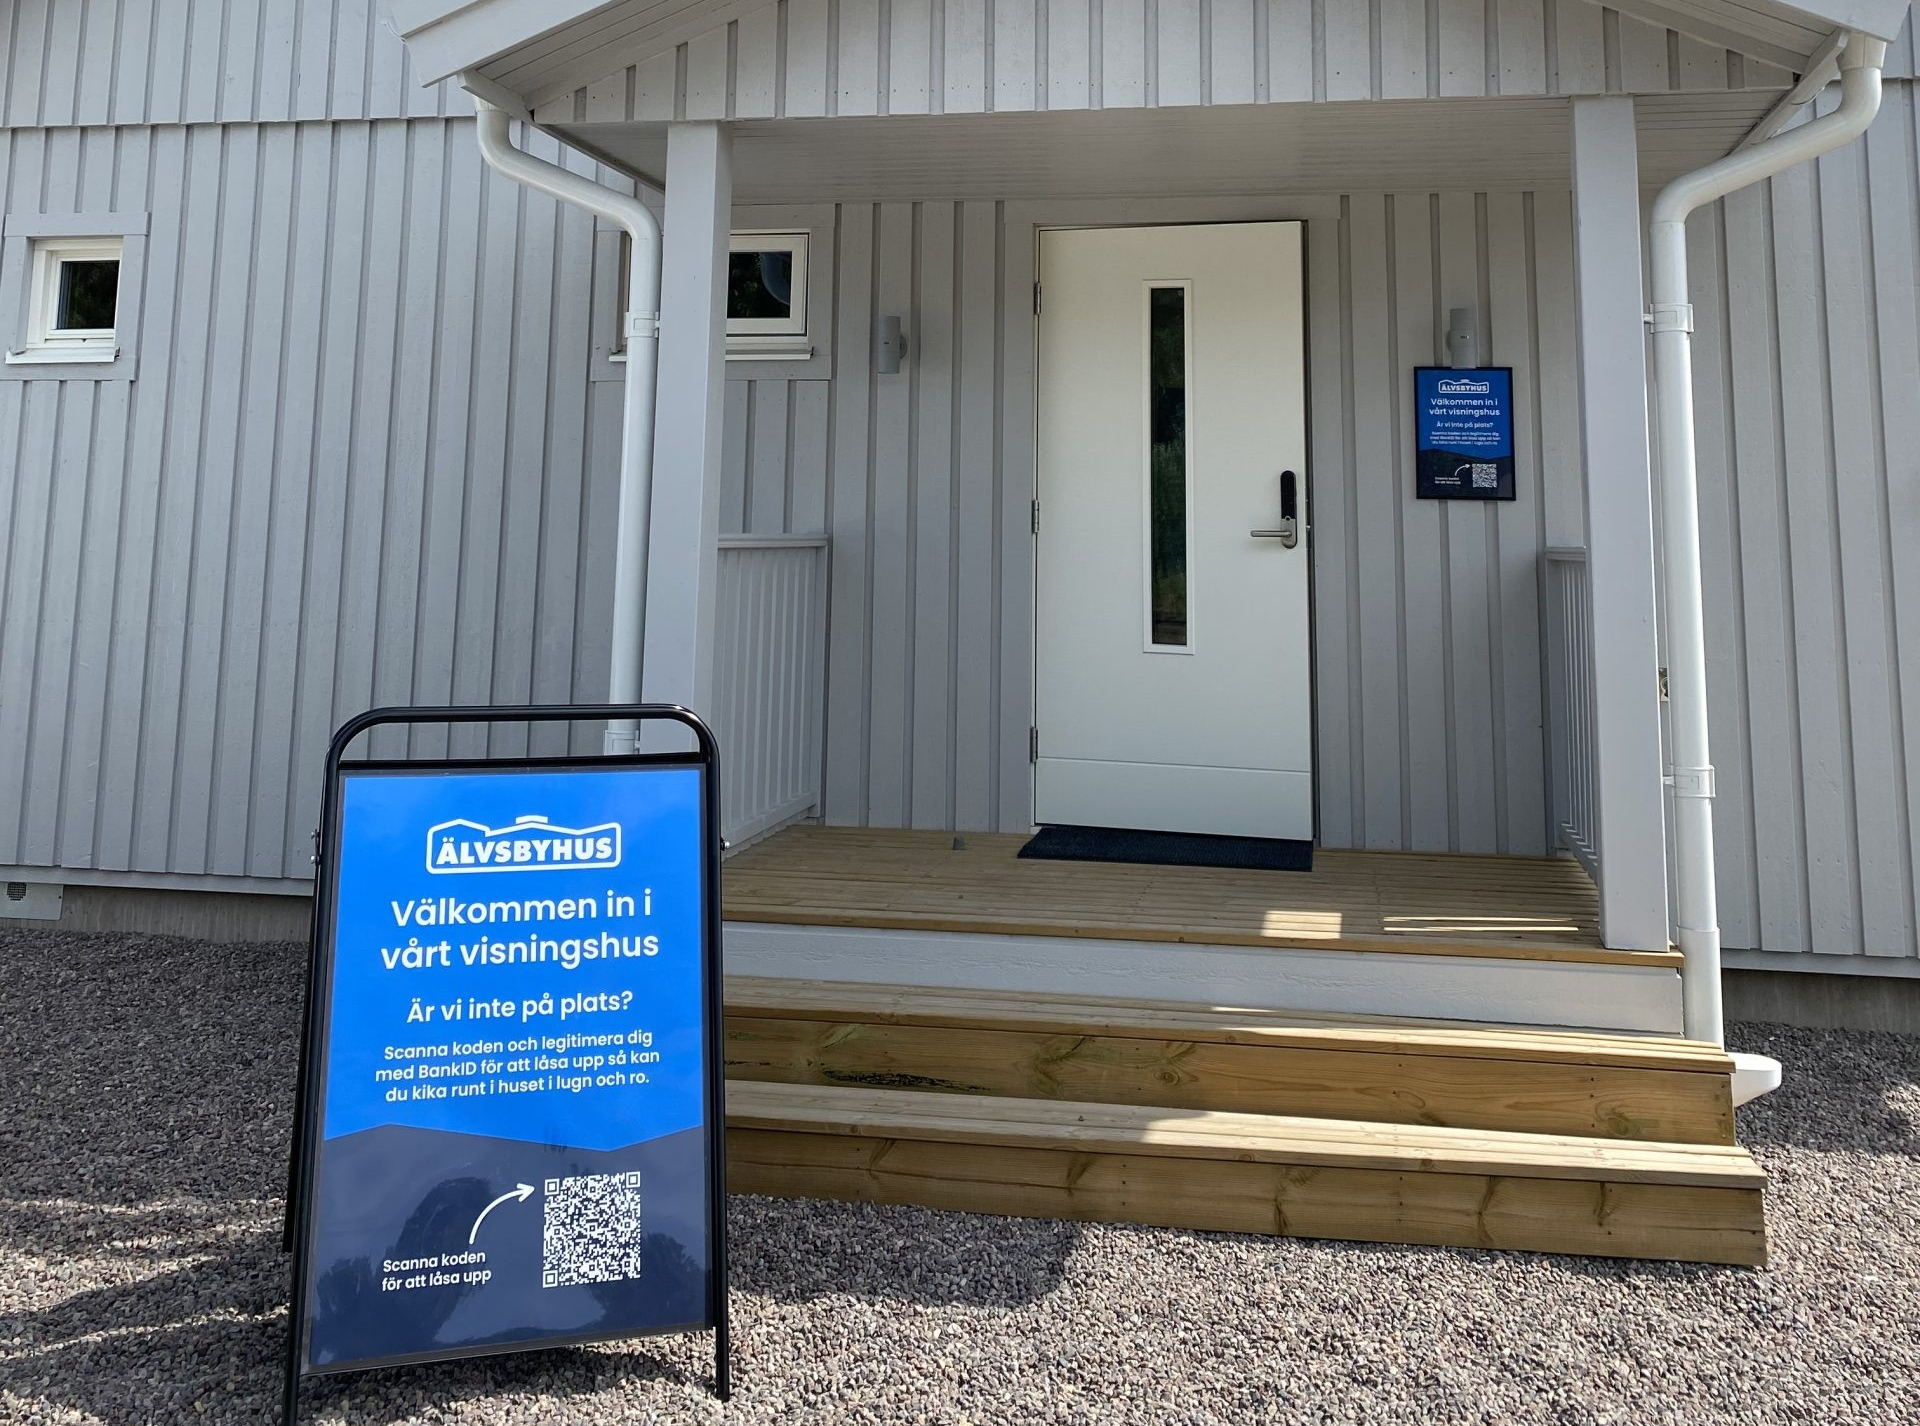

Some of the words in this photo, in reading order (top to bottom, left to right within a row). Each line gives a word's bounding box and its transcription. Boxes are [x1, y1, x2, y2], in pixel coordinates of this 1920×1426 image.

[1429, 407, 1446, 415] vårt
[1449, 408, 1500, 417] visningshus
[436, 836, 613, 865] ÄLVSBYHUS
[391, 896, 597, 927] Välkommen
[605, 889, 635, 918] in
[643, 888, 652, 916] i
[380, 937, 452, 969] vårt
[460, 932, 660, 969] visningshus
[406, 997, 436, 1023] Är
[440, 997, 463, 1021] vi
[468, 996, 516, 1019] inte
[522, 992, 555, 1022] på
[560, 990, 634, 1019] plats?
[383, 1044, 449, 1060] Scanna
[452, 1040, 504, 1057] koden
[507, 1037, 538, 1053] och
[541, 1032, 624, 1052] legitimera
[626, 1029, 653, 1048] dig
[375, 1066, 414, 1082] med
[418, 1060, 477, 1078] BankID
[480, 1059, 504, 1074] för
[506, 1058, 531, 1073] att
[534, 1054, 569, 1071] låsa
[572, 1055, 604, 1074] upp
[607, 1050, 627, 1067] så
[630, 1048, 660, 1064] kan
[385, 1085, 408, 1103] du
[411, 1081, 448, 1100] kika
[450, 1079, 487, 1097] runt
[489, 1078, 495, 1094] i
[498, 1076, 545, 1094] huset
[548, 1075, 553, 1091] i
[556, 1073, 593, 1093] lugn
[595, 1071, 626, 1087] och
[629, 1069, 650, 1085] ro.
[382, 1256, 439, 1273] Scanna
[441, 1250, 486, 1267] koden
[381, 1277, 402, 1292] för
[404, 1274, 427, 1288] att
[429, 1271, 461, 1286] låsa
[463, 1269, 492, 1286] upp
